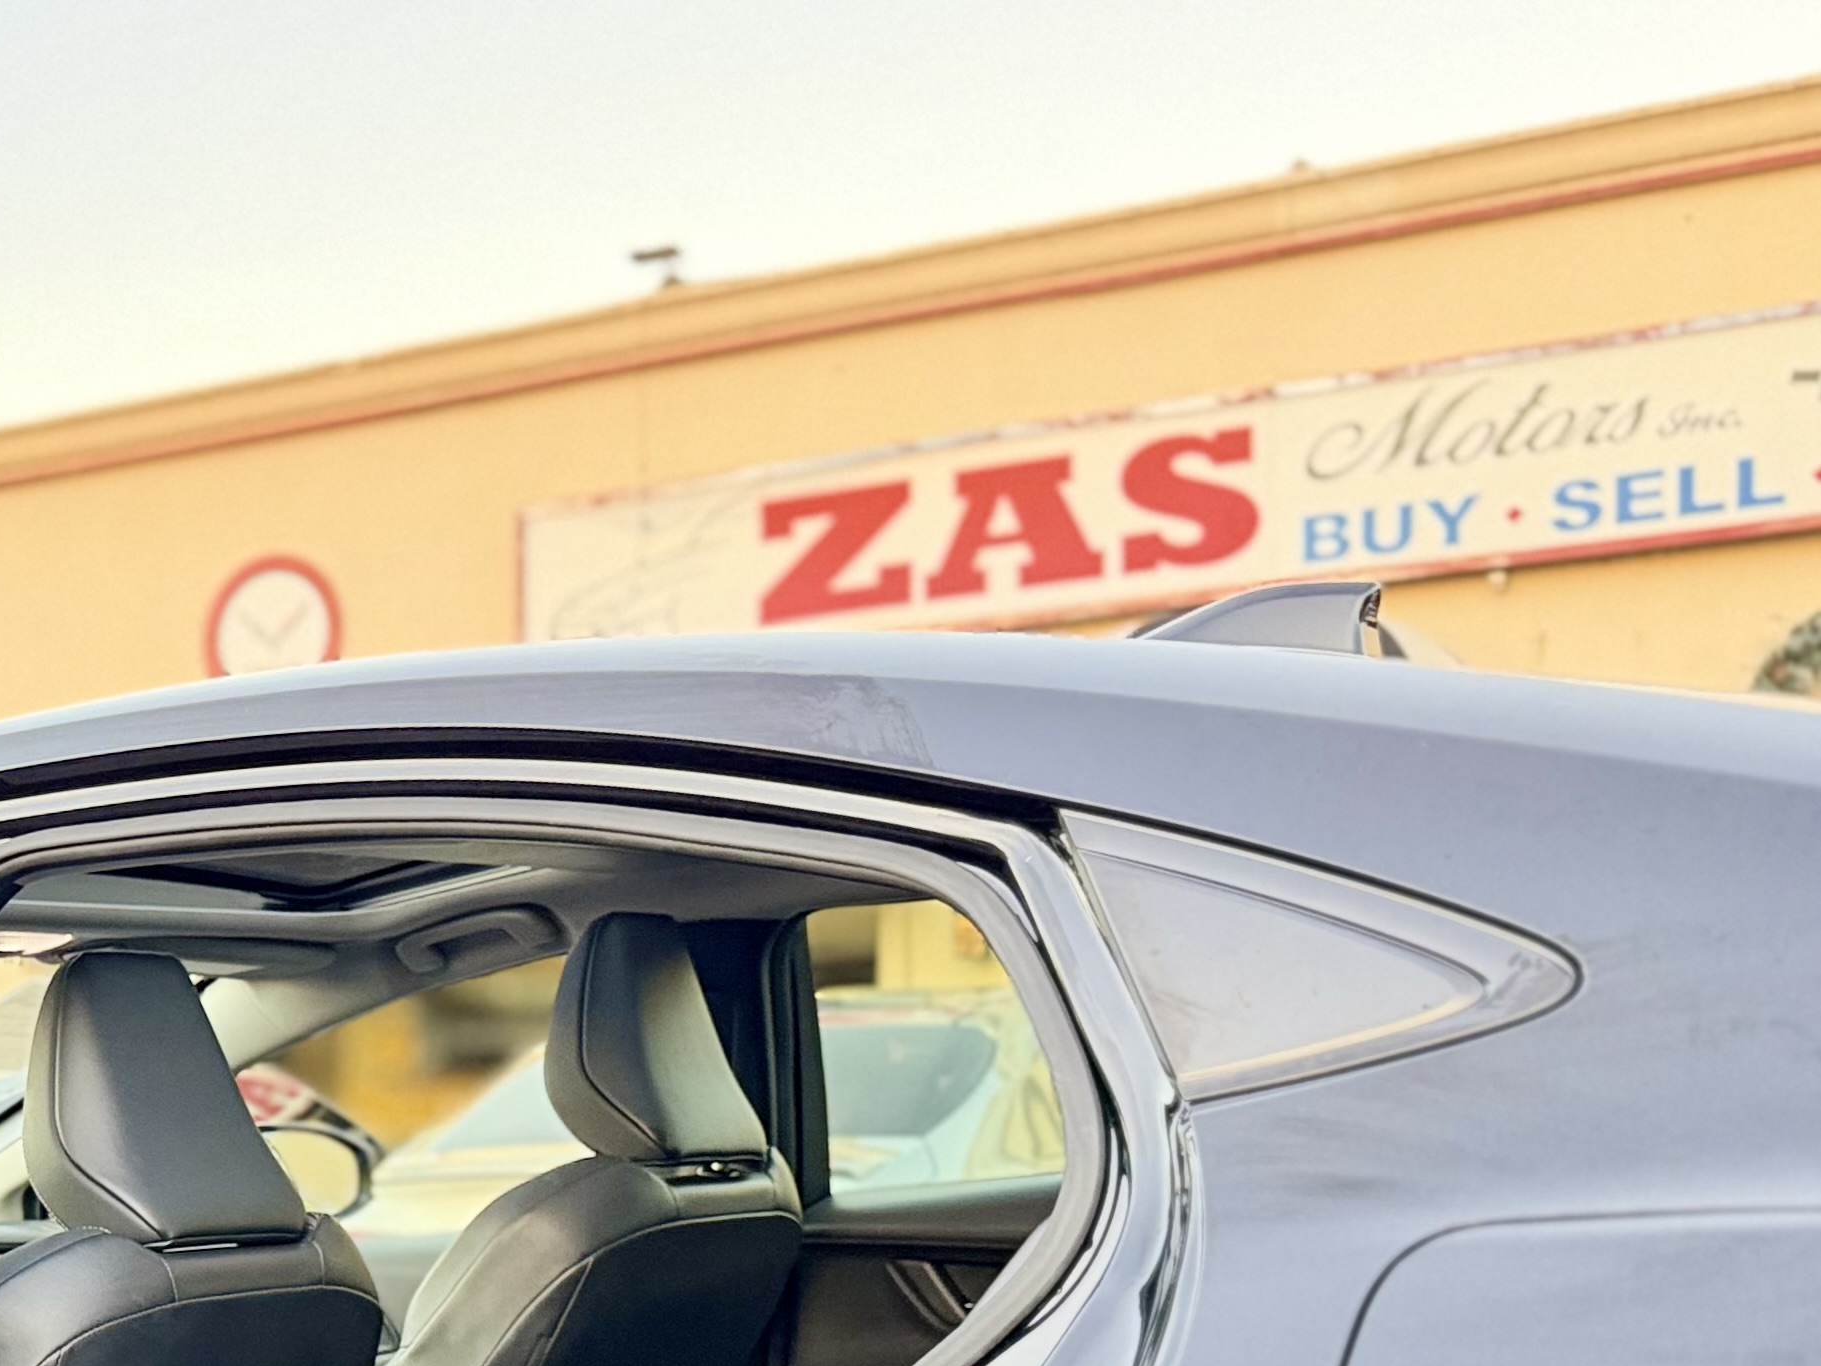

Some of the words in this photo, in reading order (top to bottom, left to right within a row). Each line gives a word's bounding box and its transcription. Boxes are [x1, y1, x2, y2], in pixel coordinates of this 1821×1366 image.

[1305, 378, 1648, 481] Motors
[759, 426, 1260, 626] ZAS
[1302, 494, 1482, 562] BUY
[1550, 457, 1786, 532] SELL
